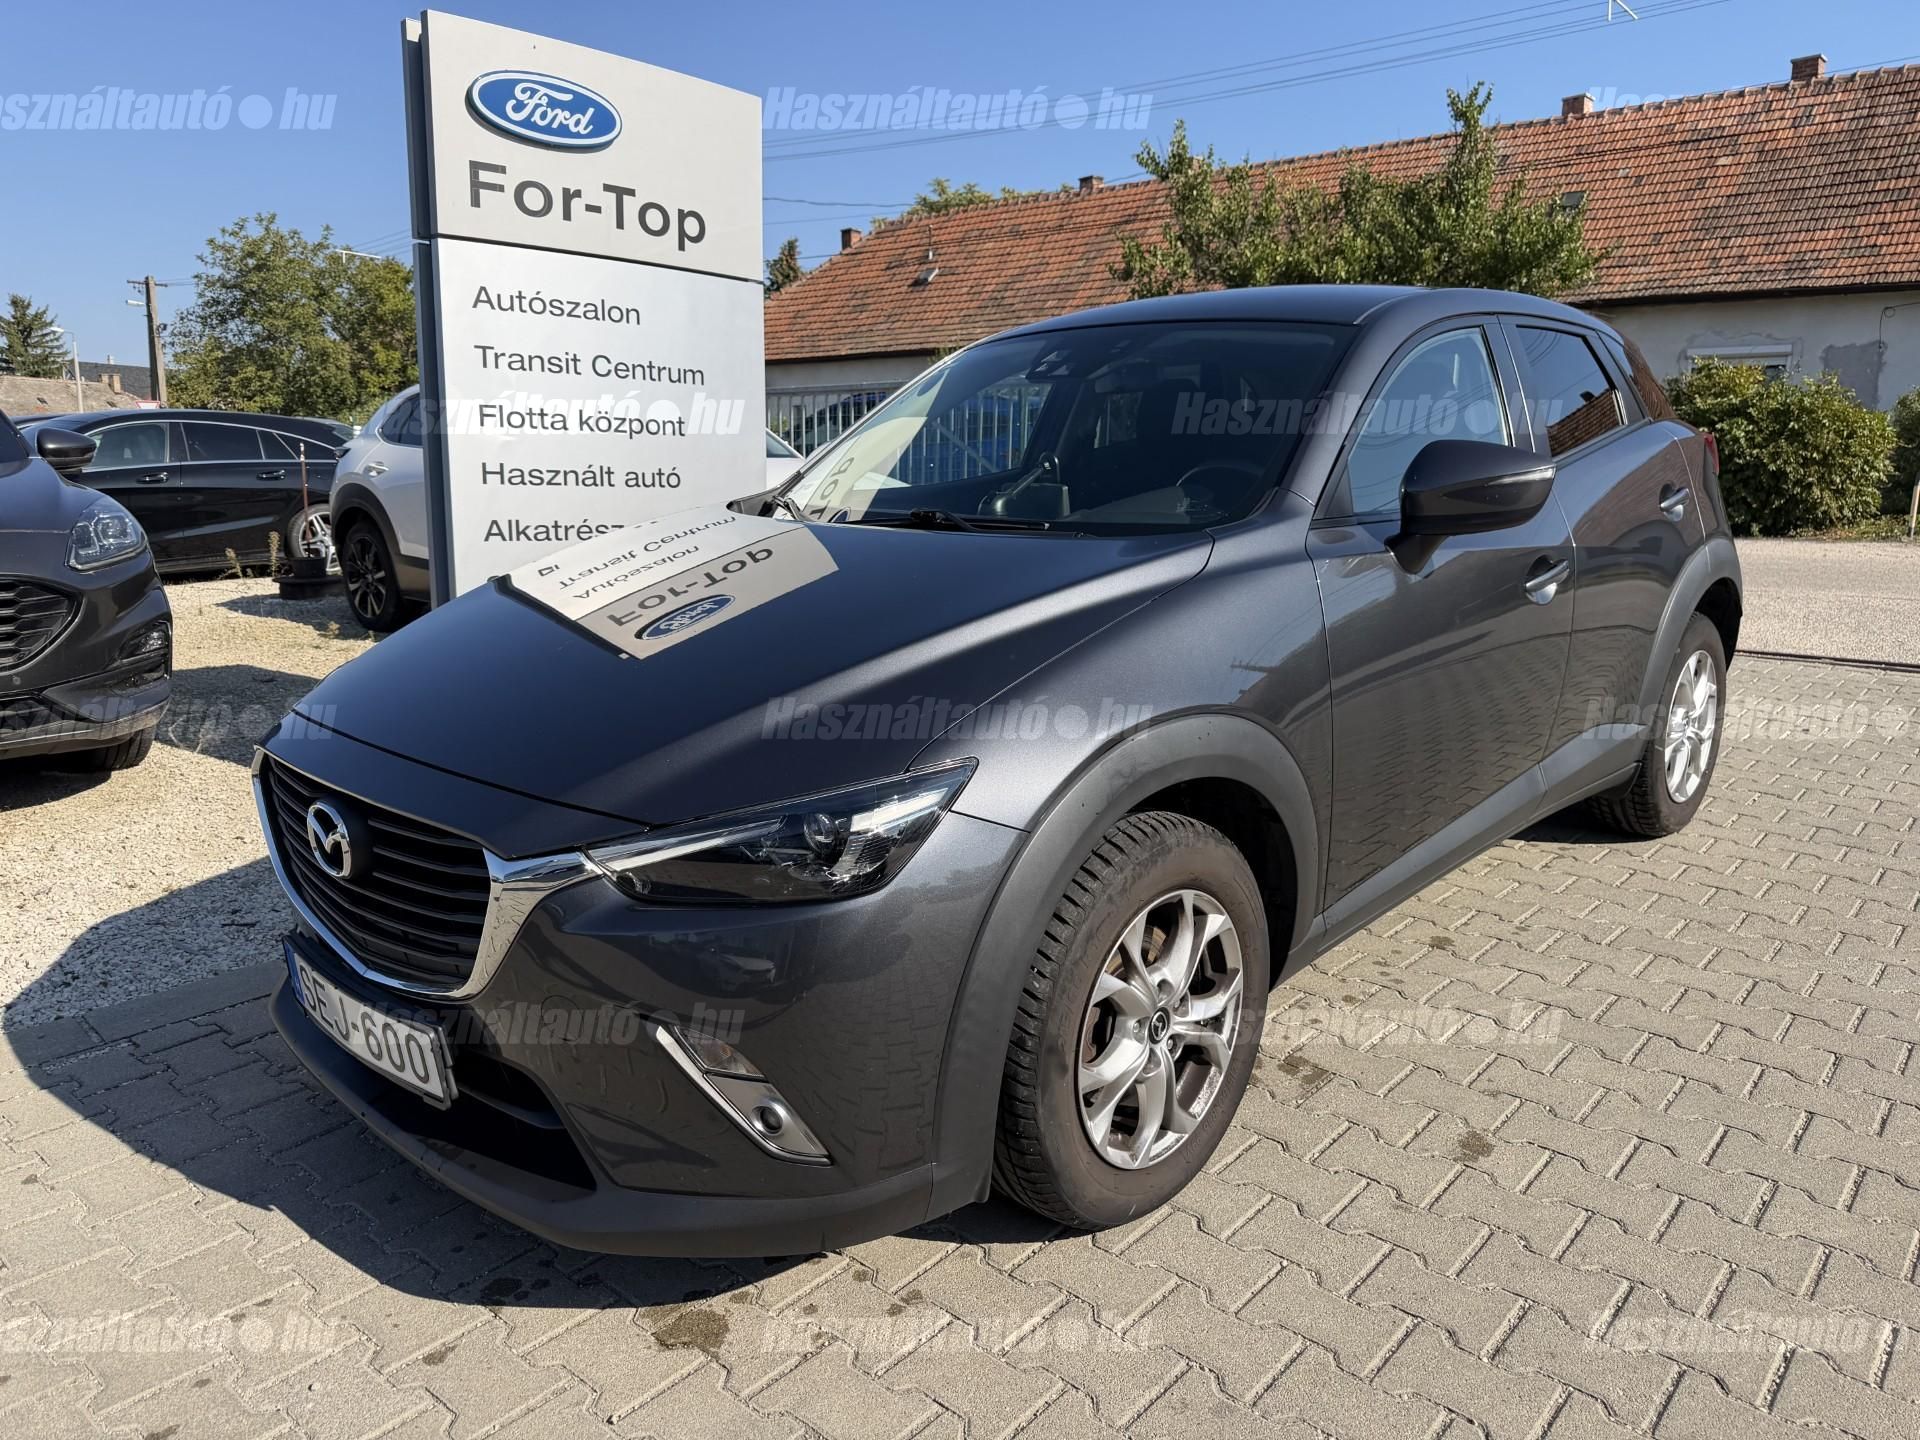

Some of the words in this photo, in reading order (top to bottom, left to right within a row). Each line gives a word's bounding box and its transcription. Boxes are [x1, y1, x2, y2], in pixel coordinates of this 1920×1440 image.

[505, 82, 596, 135] Ford
[468, 159, 706, 251] For-Top
[472, 286, 641, 326] Autószalon
[474, 345, 582, 376] Transit
[591, 354, 705, 386] Centrum
[479, 404, 569, 431] Flotta
[579, 409, 686, 440] központ
[481, 462, 616, 488] Használt
[624, 466, 681, 489] autó
[484, 518, 625, 542] Alkatrés
[299, 964, 430, 1084] SEJ-600
